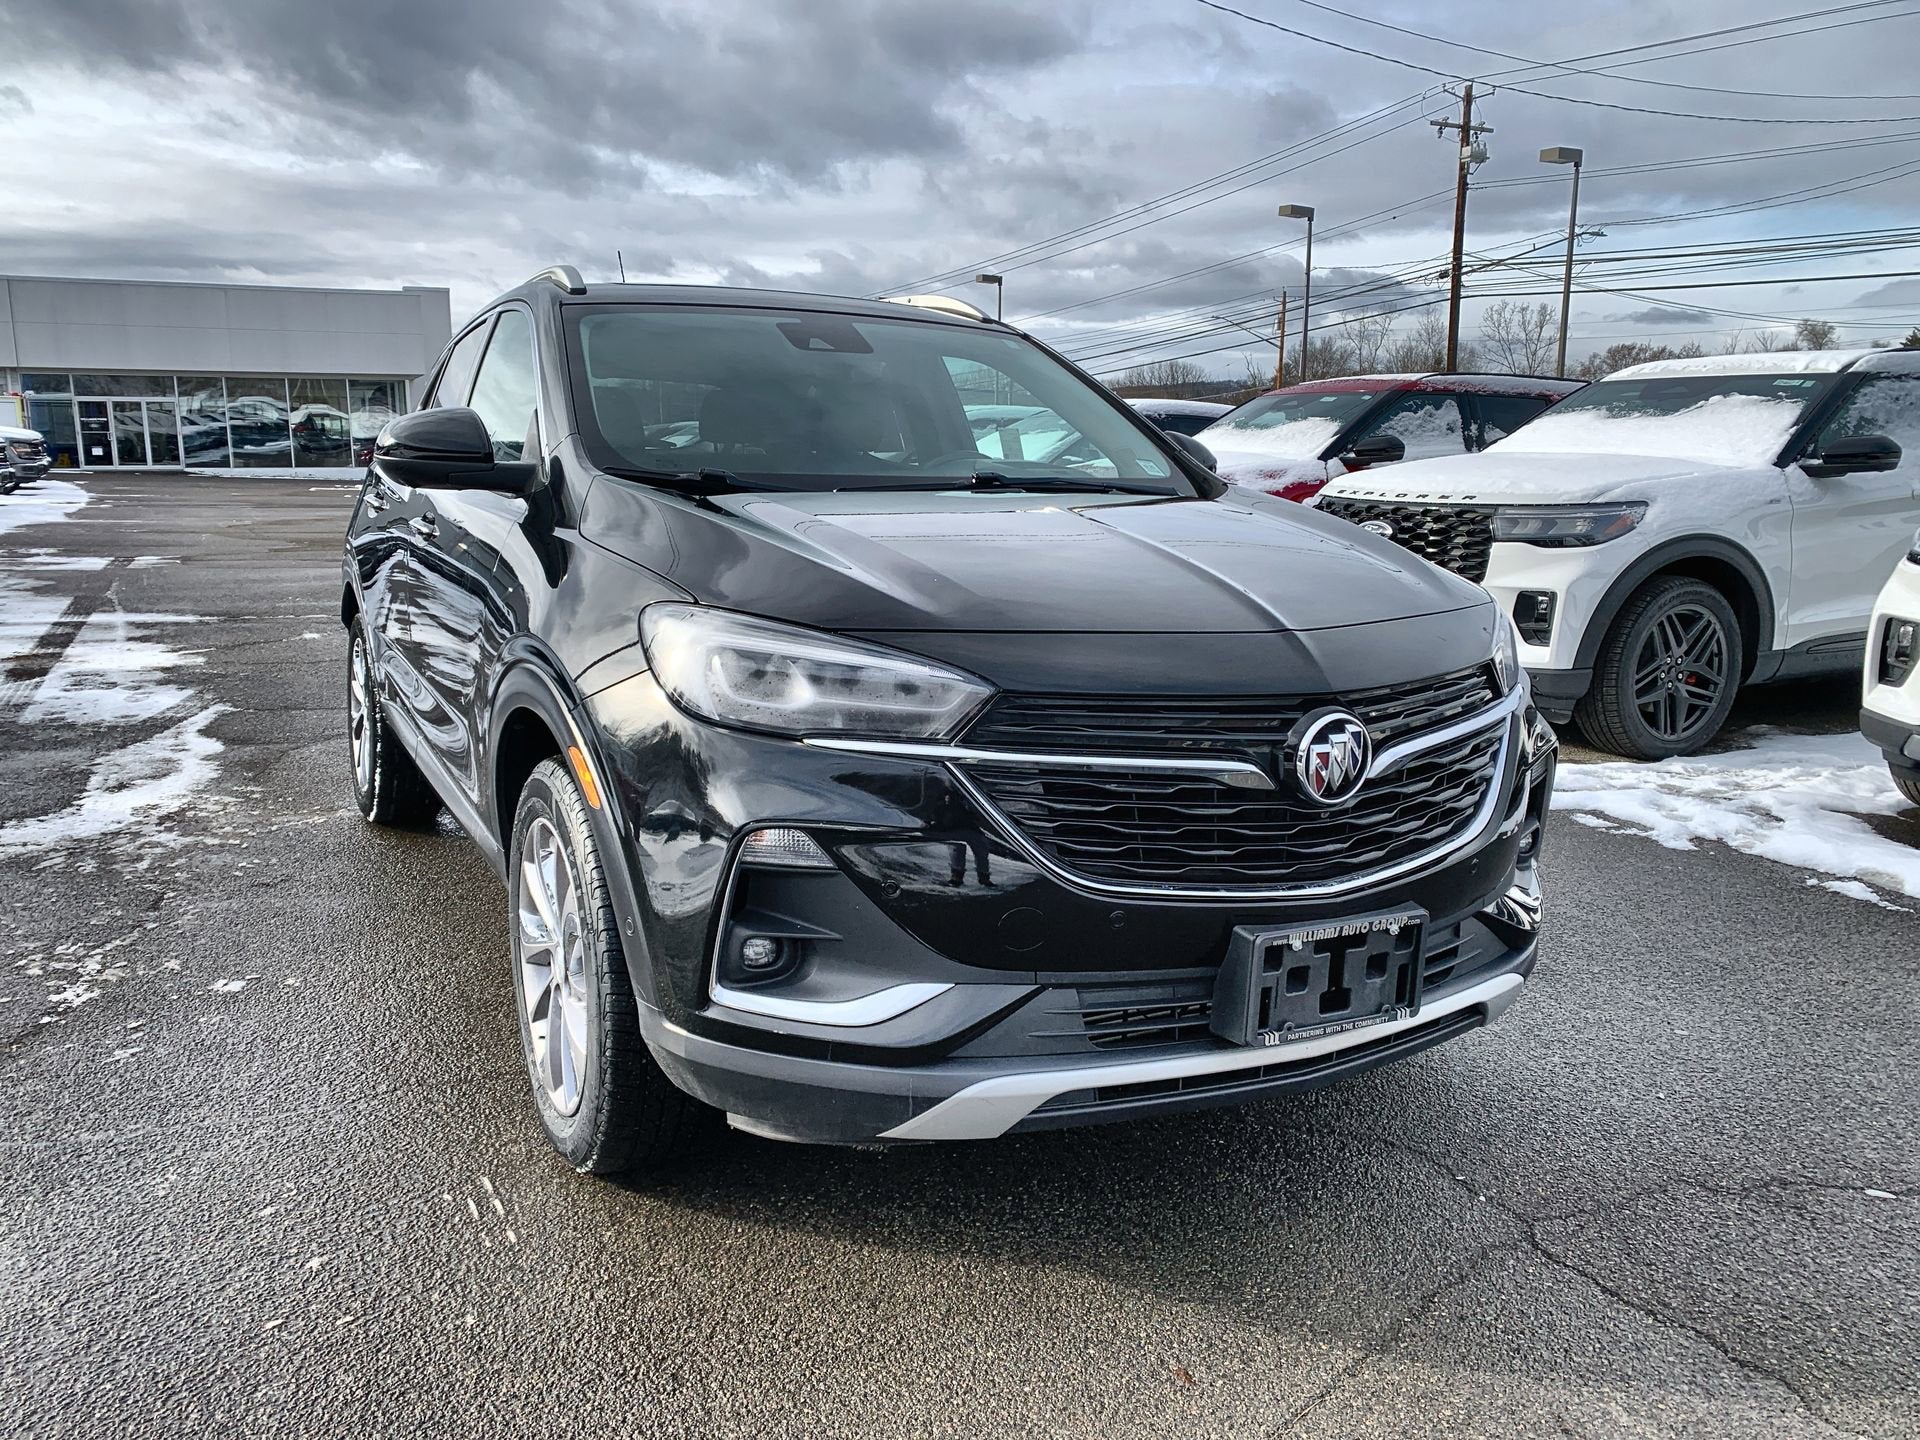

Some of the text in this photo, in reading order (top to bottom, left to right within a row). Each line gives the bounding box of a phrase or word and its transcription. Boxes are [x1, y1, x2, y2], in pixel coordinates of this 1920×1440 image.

[1337, 489, 1477, 501] EXPLORER
[1341, 921, 1370, 937] AUTO
[1287, 1016, 1389, 1041] PARTNERING WITH THE COMMUNITY
